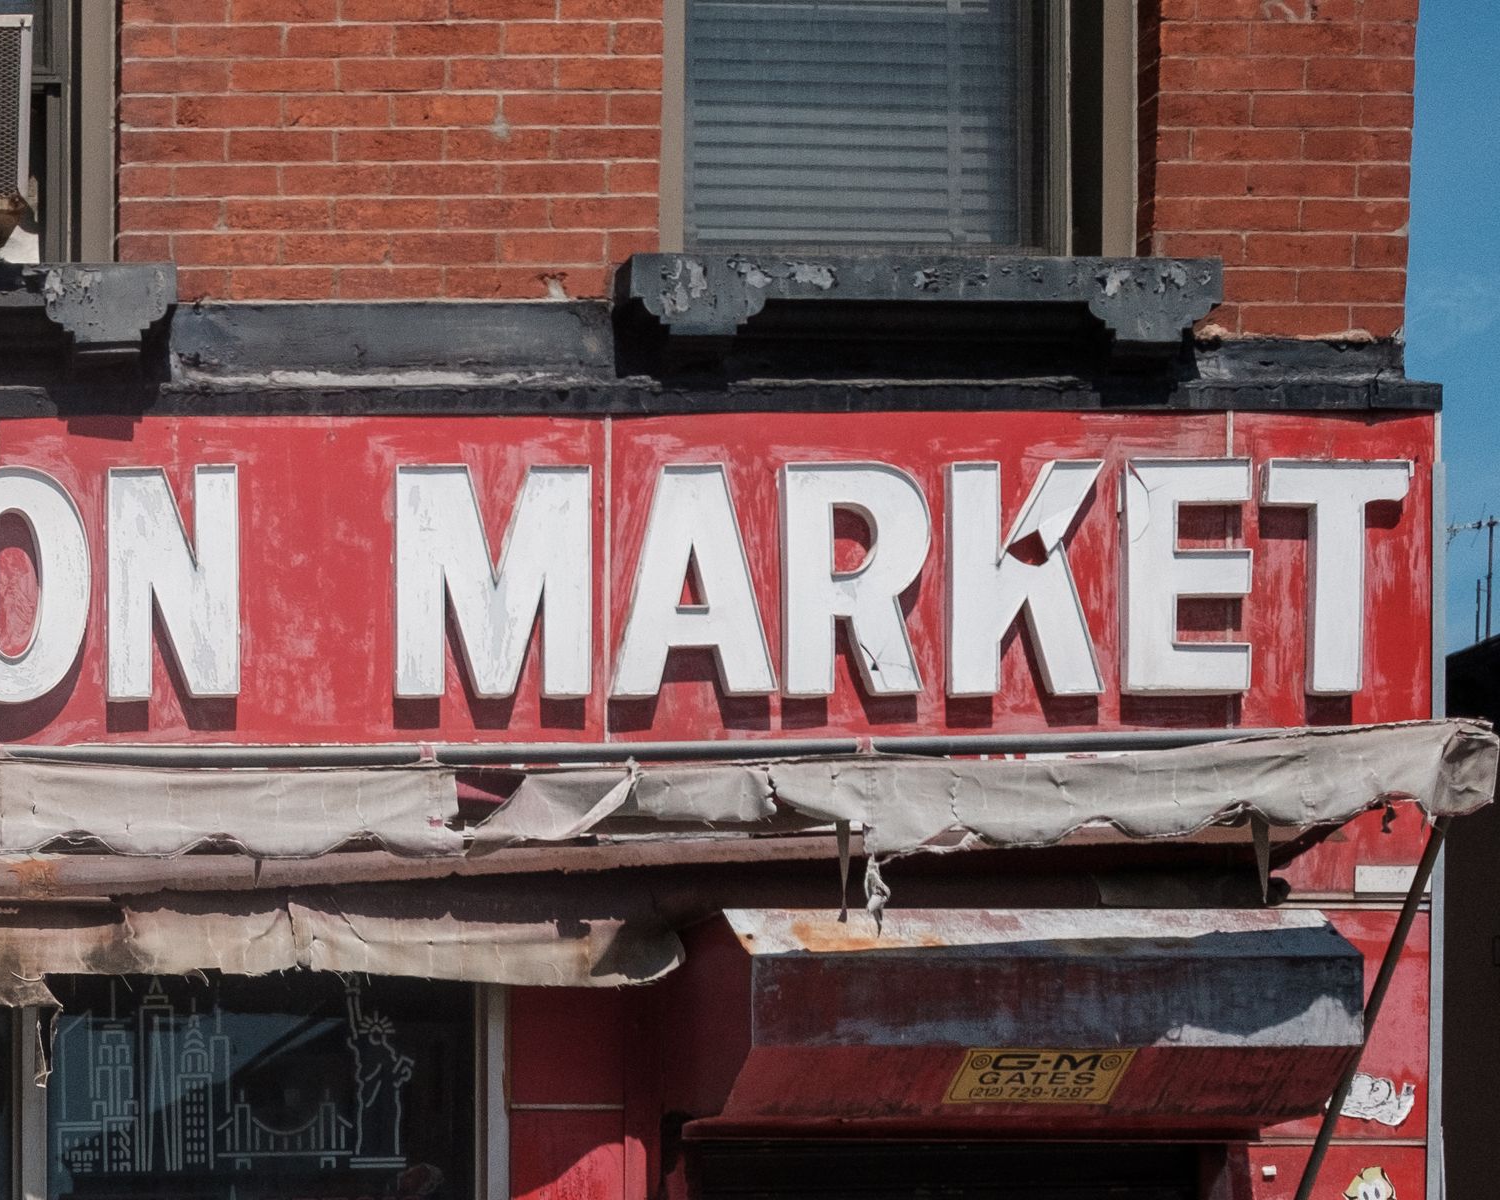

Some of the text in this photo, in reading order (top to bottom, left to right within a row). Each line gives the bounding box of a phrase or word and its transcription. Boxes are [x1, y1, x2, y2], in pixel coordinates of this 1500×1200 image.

[394, 457, 1415, 699] MARKET
[991, 1054, 1103, 1071] G-M
[978, 1072, 1096, 1085] GATES
[969, 1086, 1096, 1098] (212) 729-1287
